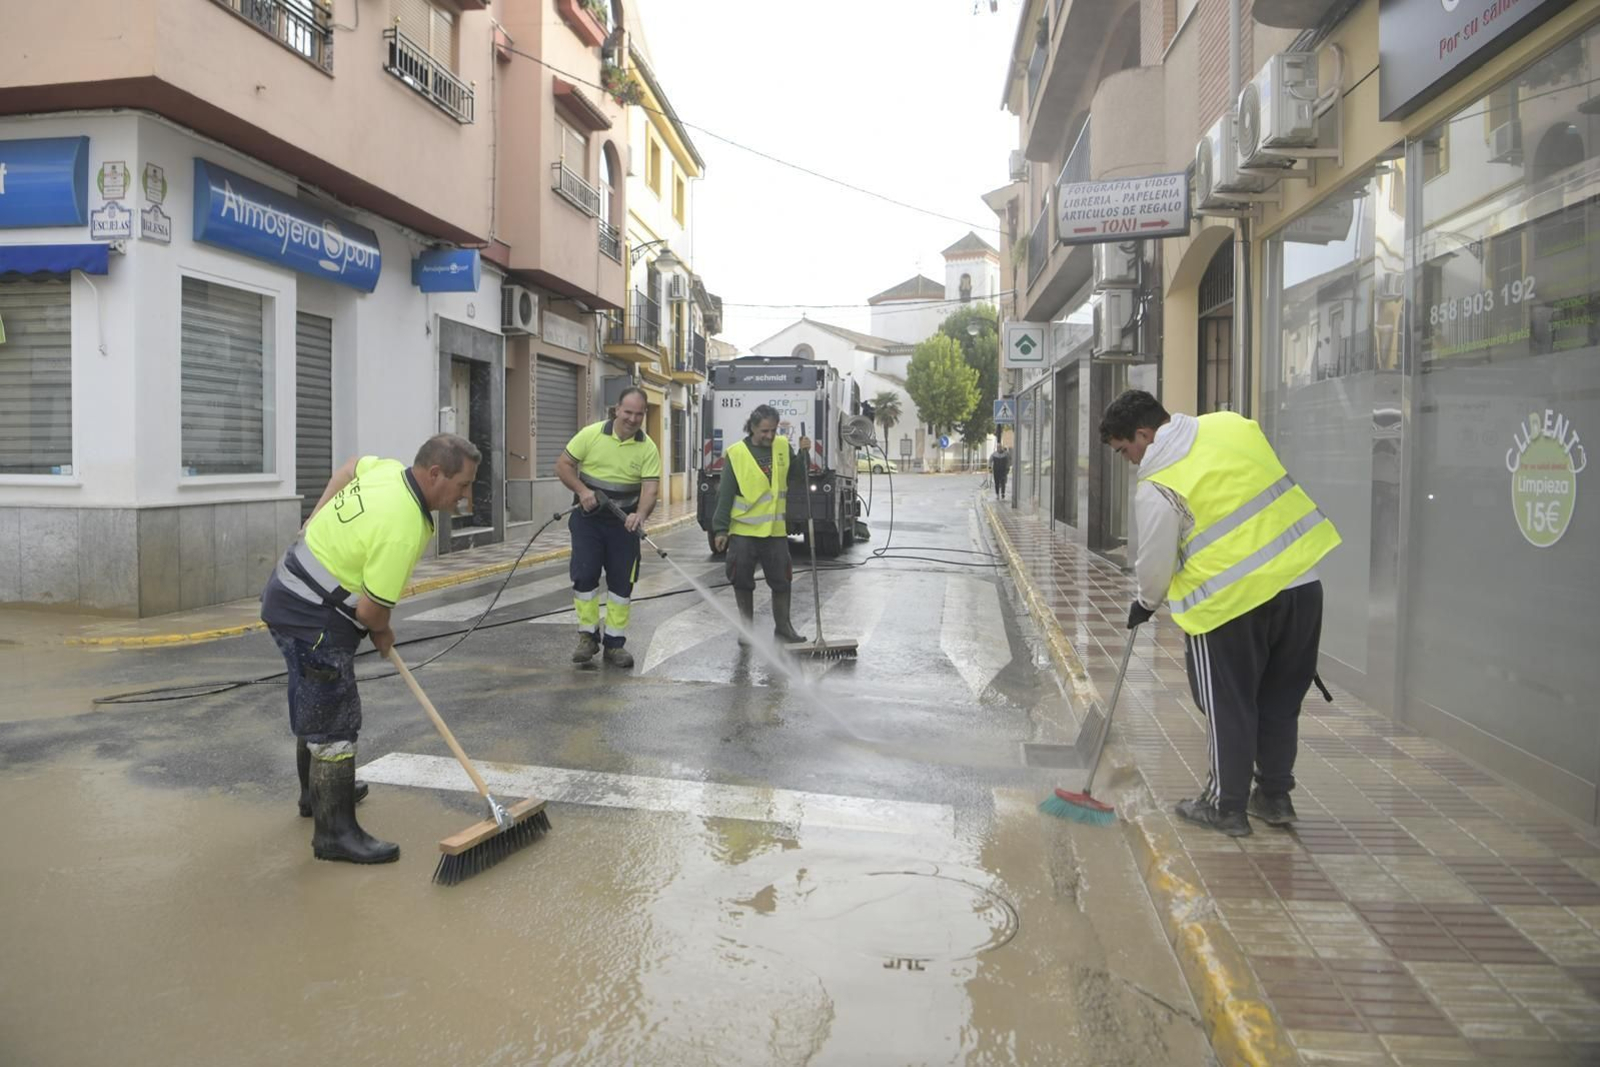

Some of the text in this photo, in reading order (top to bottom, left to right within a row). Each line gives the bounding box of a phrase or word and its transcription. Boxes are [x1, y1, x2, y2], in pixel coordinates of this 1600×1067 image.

[1440, 32, 1460, 60] Por
[1464, 17, 1478, 40] su
[1122, 188, 1180, 203] PAPELERIA
[1062, 201, 1182, 221] ARTICULOS DE REGALO
[93, 220, 130, 231] ESCUELAS
[143, 218, 169, 236] IGLESIA
[1101, 218, 1138, 233] TONI
[1430, 301, 1457, 325] 858
[1463, 290, 1494, 318] 903
[1501, 276, 1536, 306] 192
[755, 374, 787, 382] schmidt
[721, 398, 741, 408] 815
[778, 408, 798, 416] ero
[1518, 476, 1570, 496] Limpieza
[1525, 500, 1561, 534] 15€
